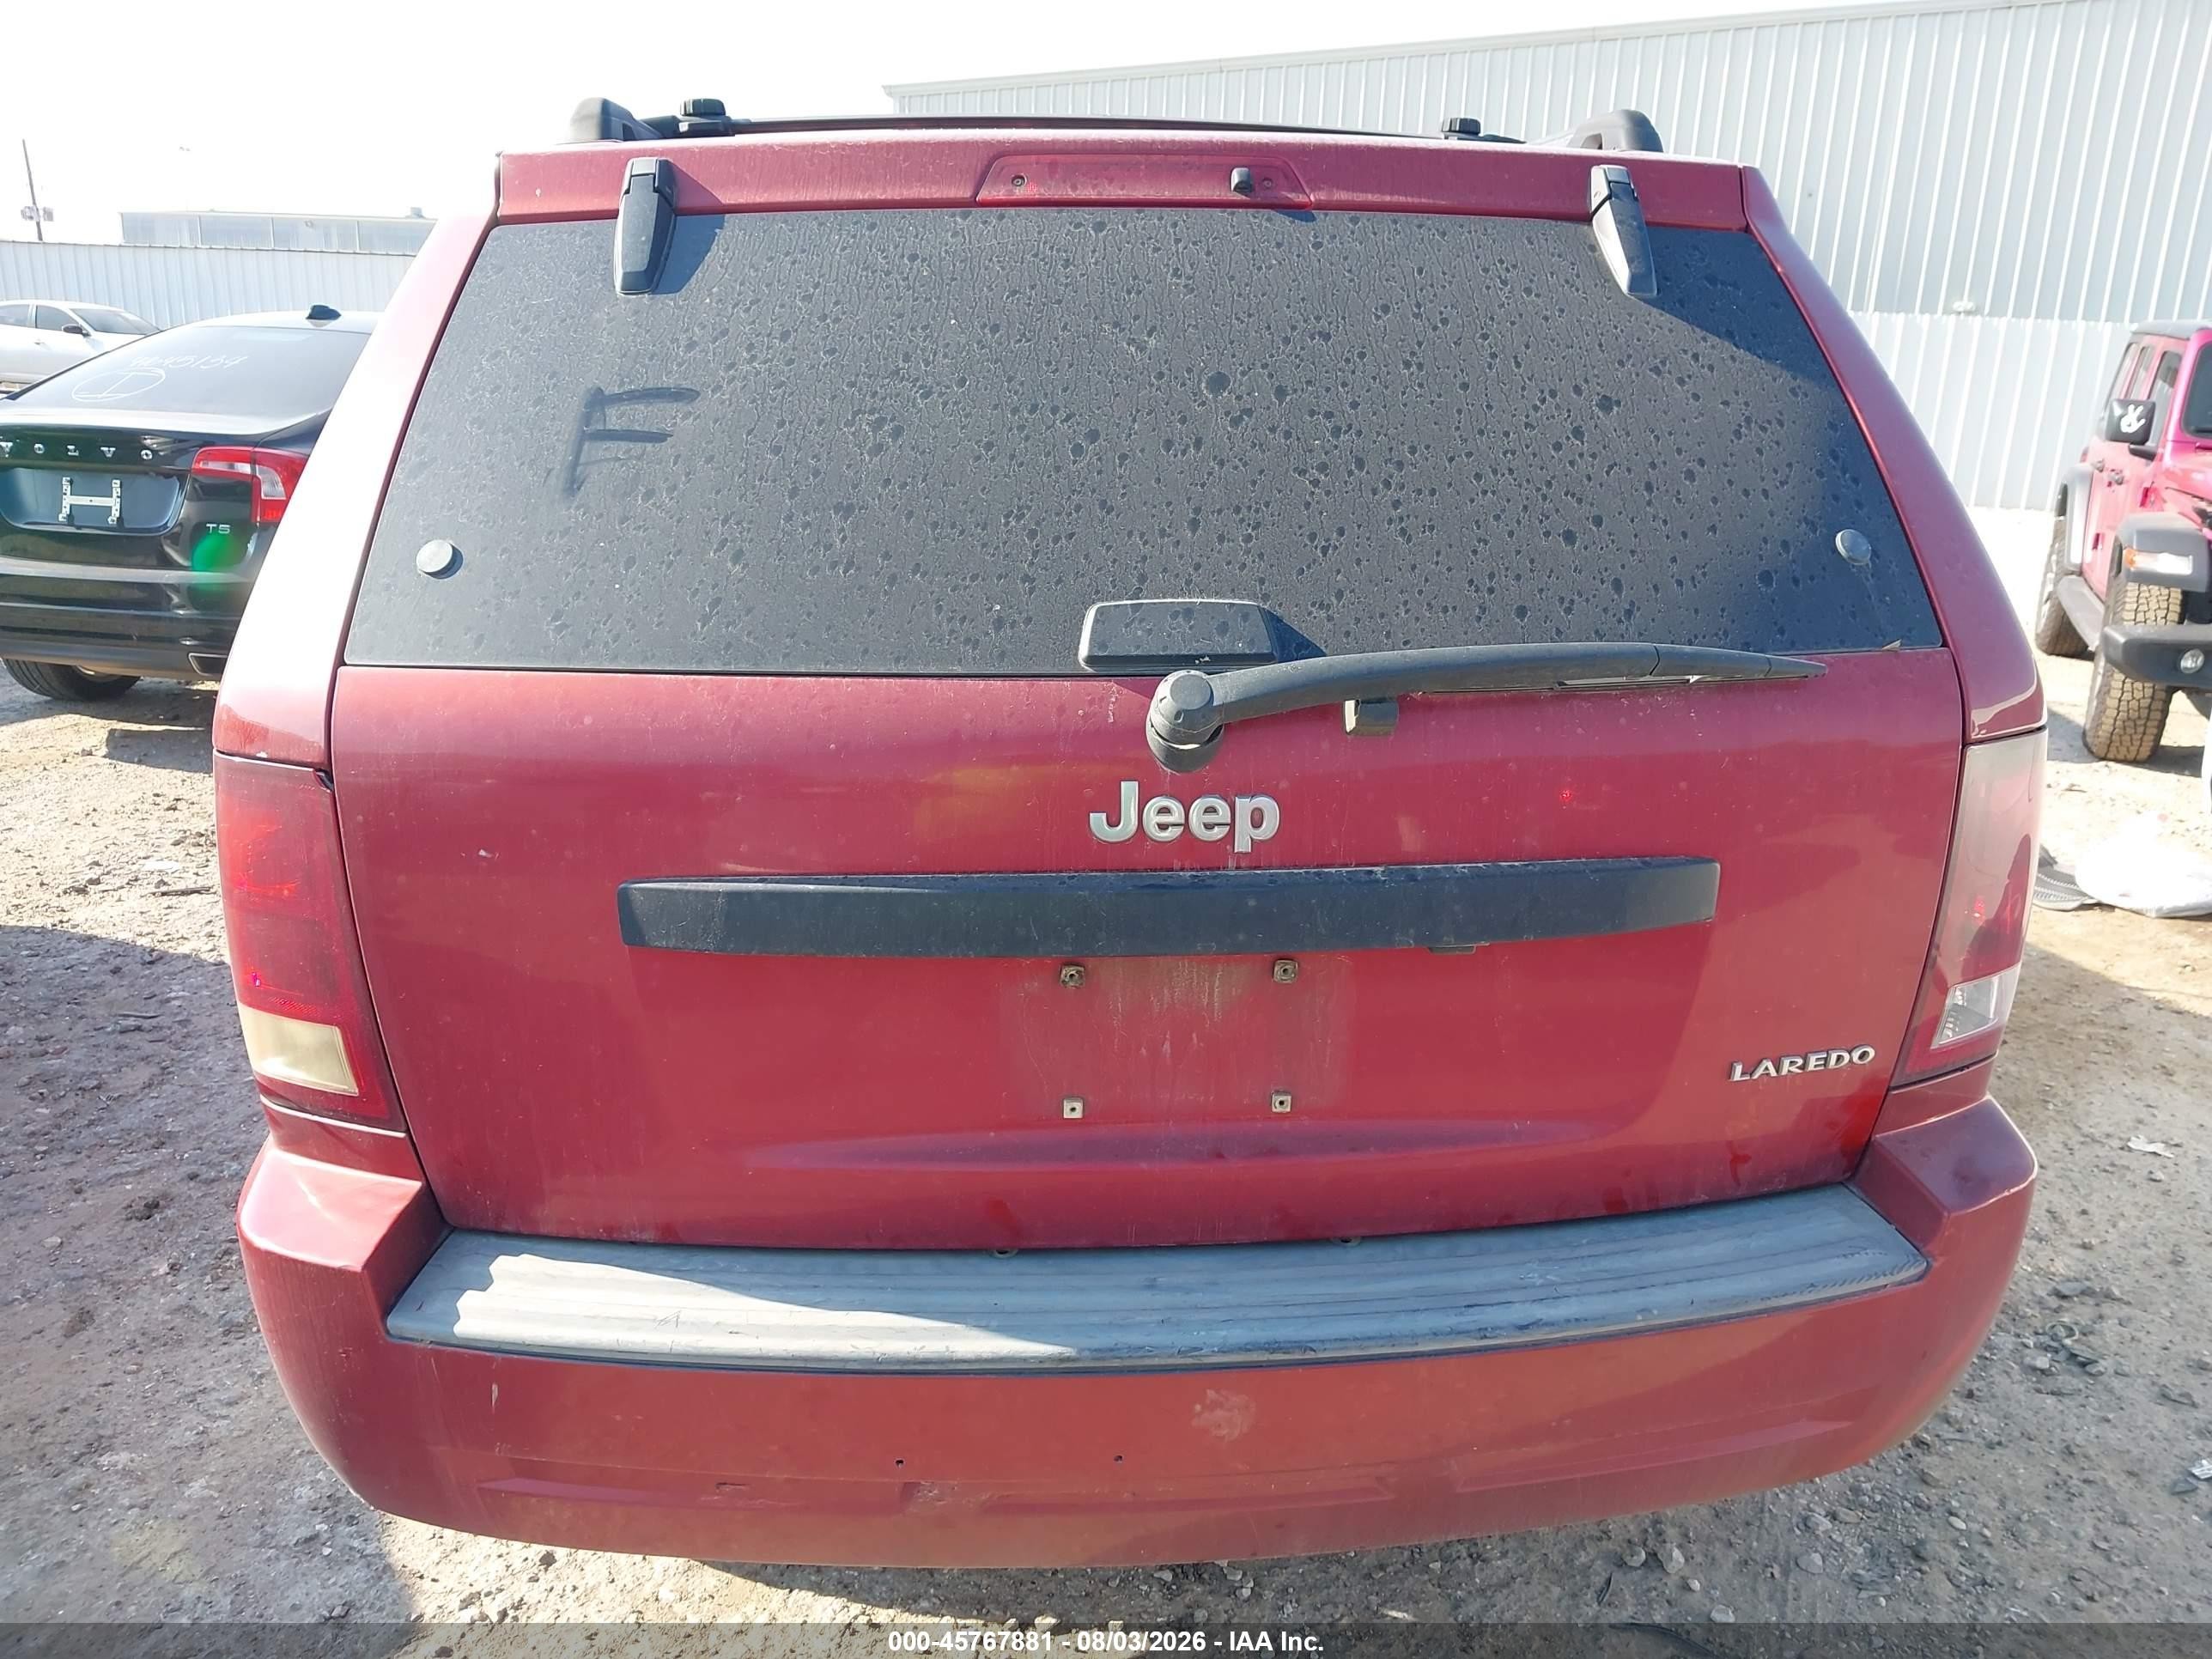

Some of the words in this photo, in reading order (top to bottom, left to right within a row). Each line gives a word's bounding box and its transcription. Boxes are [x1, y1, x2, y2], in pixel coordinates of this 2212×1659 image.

[0, 441, 153, 460] VOLVO
[206, 524, 231, 534] T5
[1089, 781, 1279, 853] Jeep
[1729, 1044, 1876, 1082] LAREDO
